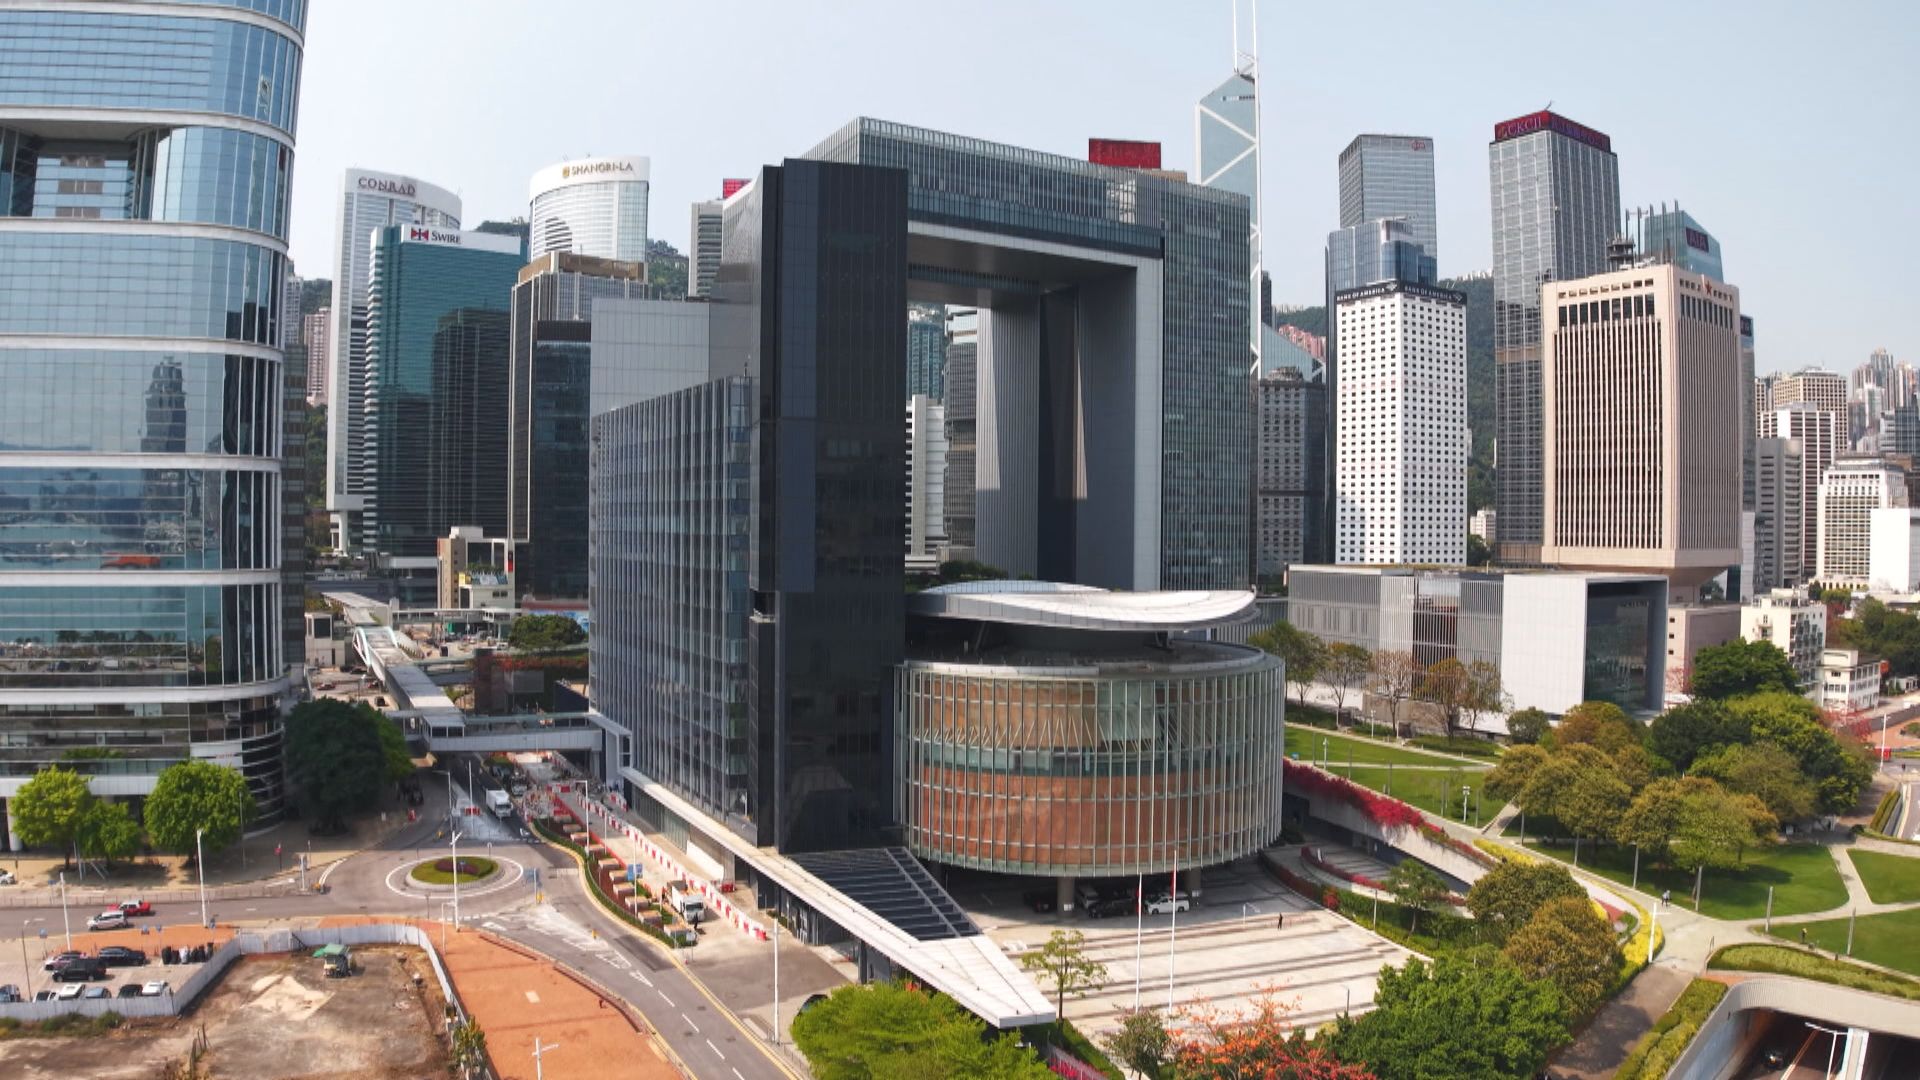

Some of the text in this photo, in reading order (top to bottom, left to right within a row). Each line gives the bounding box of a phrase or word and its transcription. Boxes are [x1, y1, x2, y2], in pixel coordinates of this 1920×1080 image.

[572, 161, 633, 175] SHANGRI-LA
[358, 176, 416, 198] CONRAD
[431, 230, 462, 244] SWIRE
